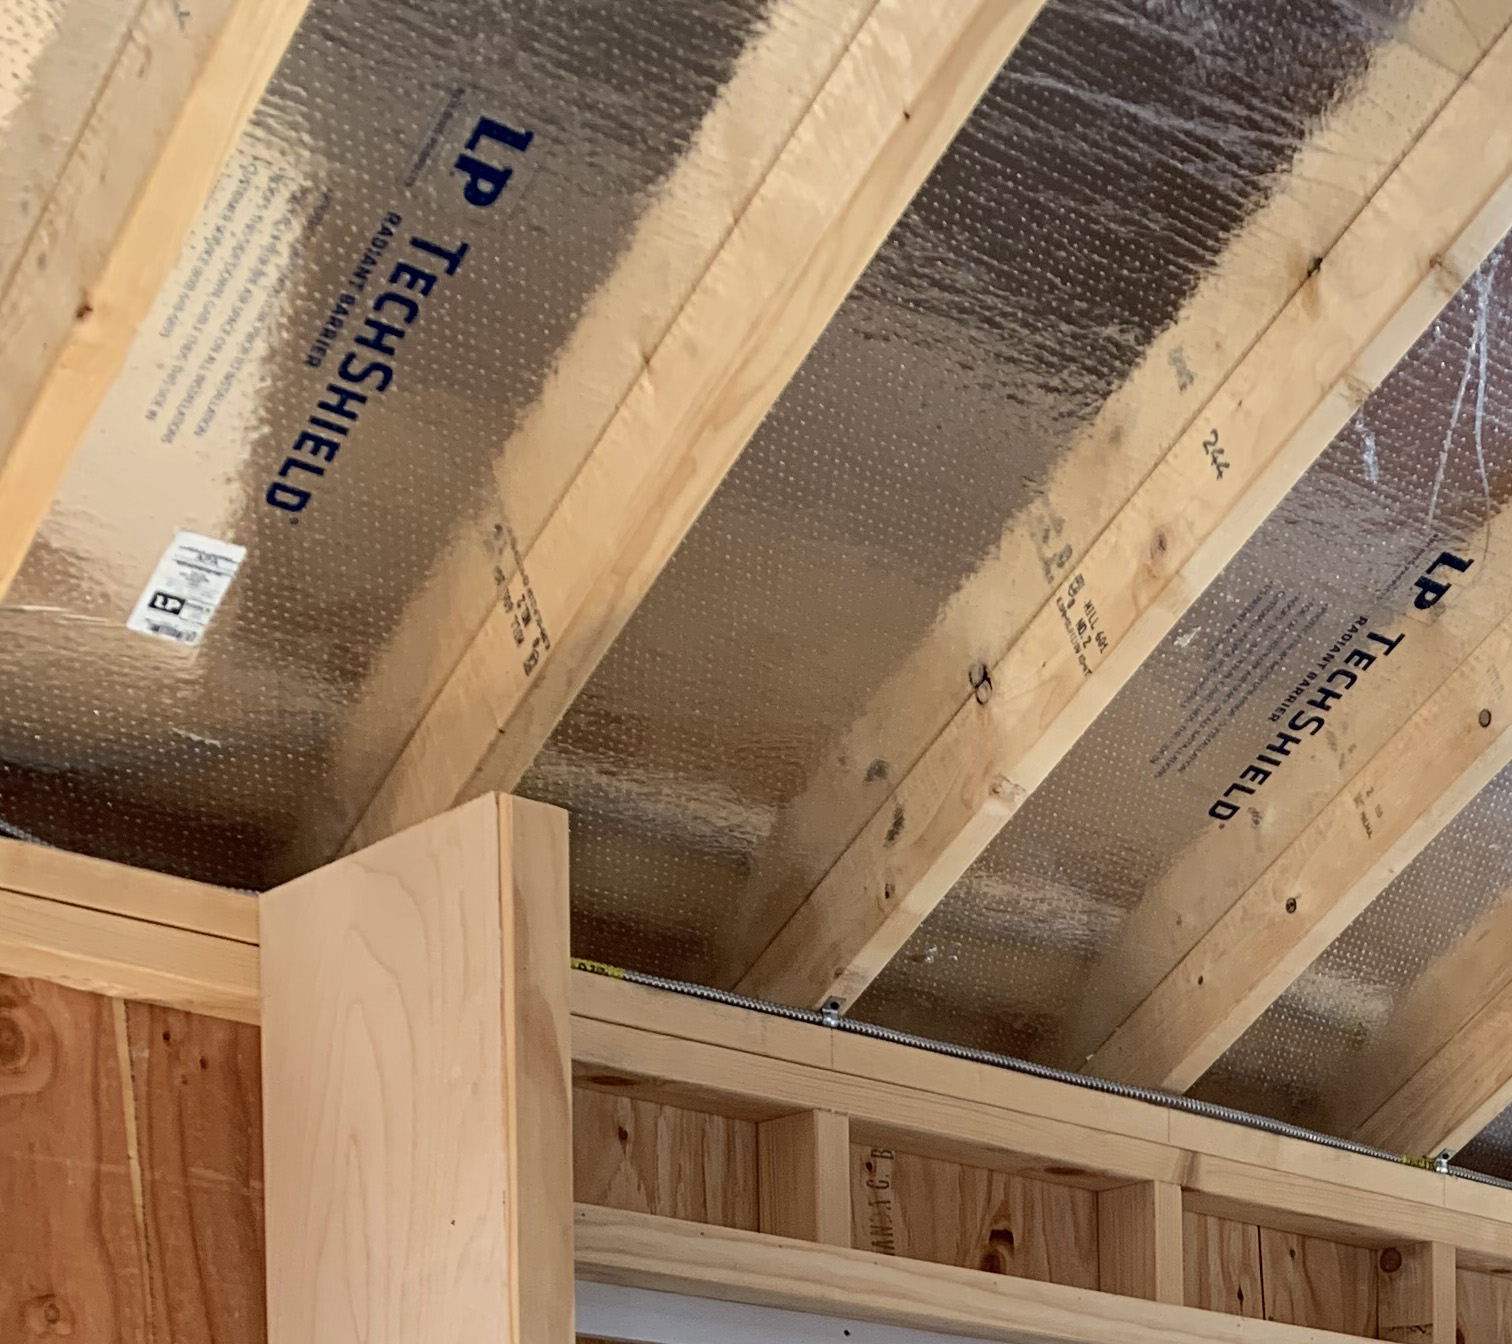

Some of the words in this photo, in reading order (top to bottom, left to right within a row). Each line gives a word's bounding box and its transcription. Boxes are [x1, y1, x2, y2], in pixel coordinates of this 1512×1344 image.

[455, 115, 533, 207] LP
[353, 211, 402, 280] RADIANT
[305, 280, 358, 369] BARRIER
[1414, 551, 1475, 610] LP
[1081, 599, 1102, 630] MILL
[1315, 615, 1369, 670] RADIANT
[1267, 670, 1319, 723] BARRIER
